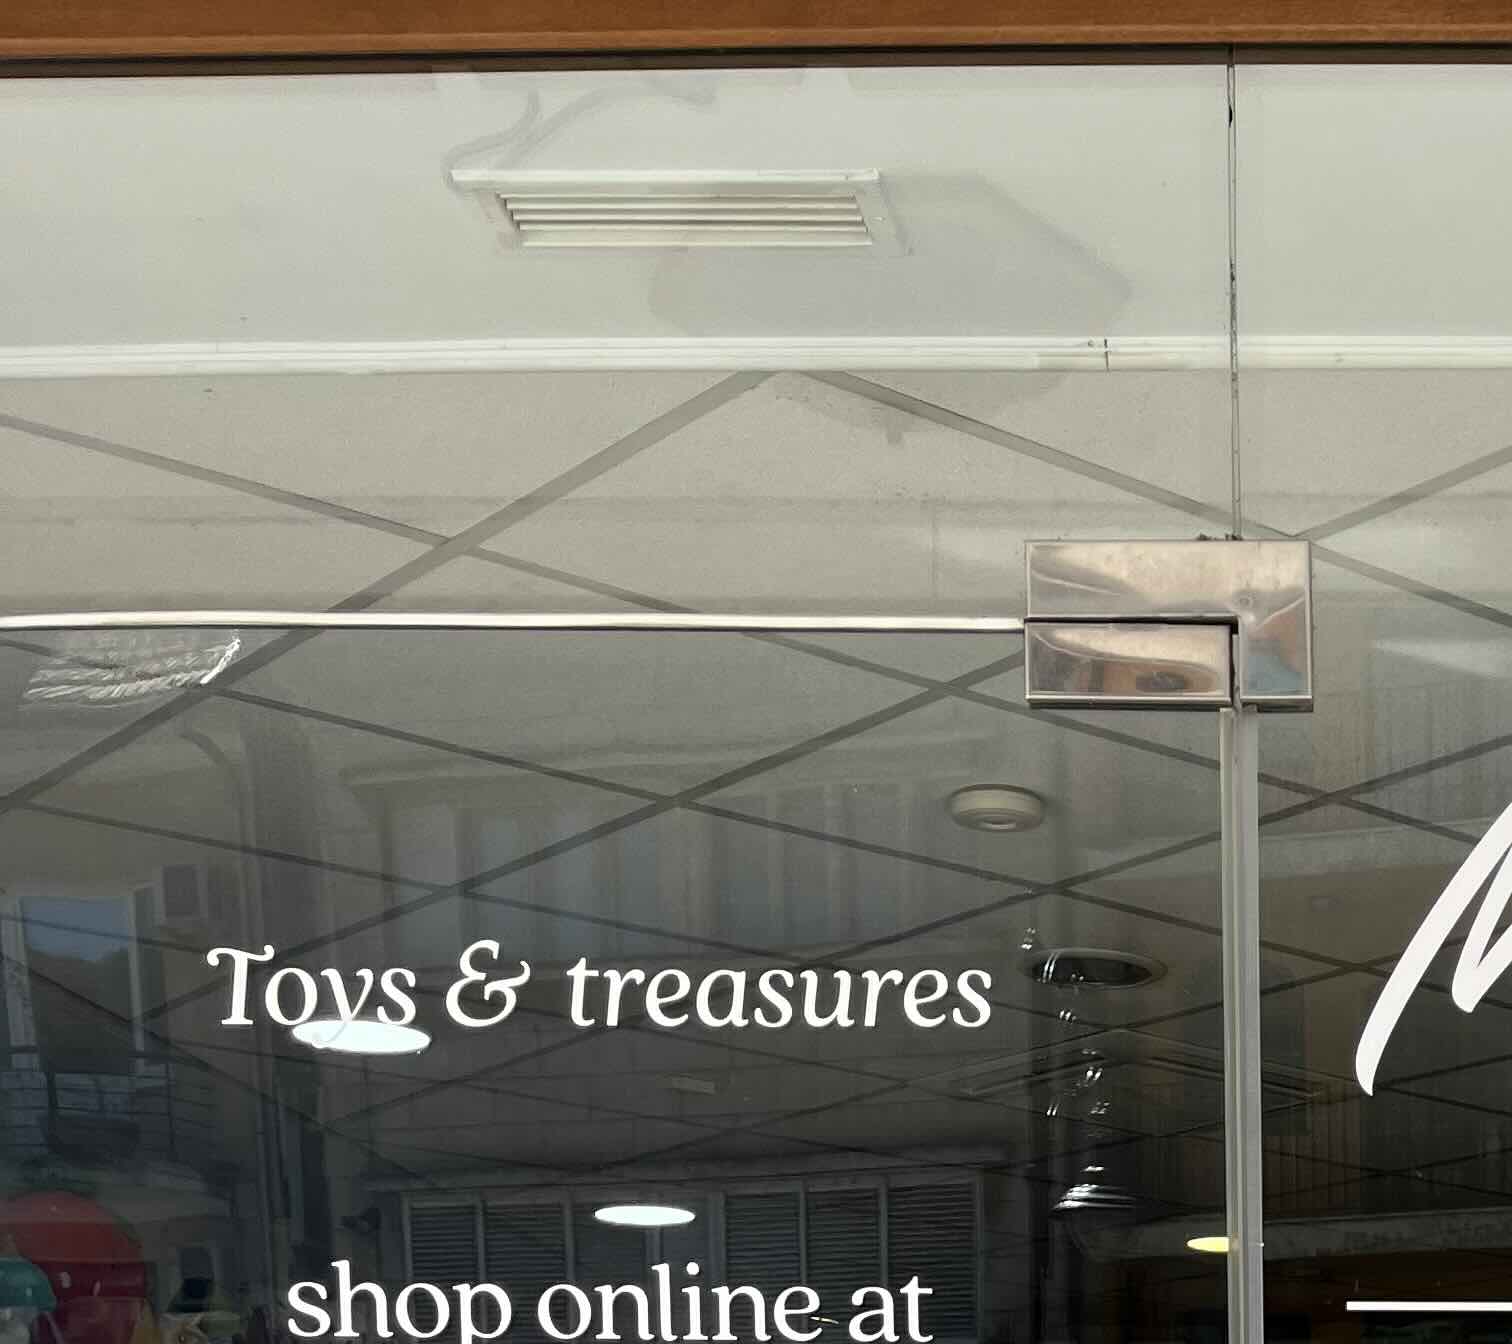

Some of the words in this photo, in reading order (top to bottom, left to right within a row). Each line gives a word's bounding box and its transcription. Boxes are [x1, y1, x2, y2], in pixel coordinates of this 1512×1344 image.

[206, 943, 417, 1049] Toys
[445, 939, 531, 1028] &
[566, 956, 993, 1029] treasures
[537, 1261, 822, 1342] online
[848, 1275, 934, 1343] at
